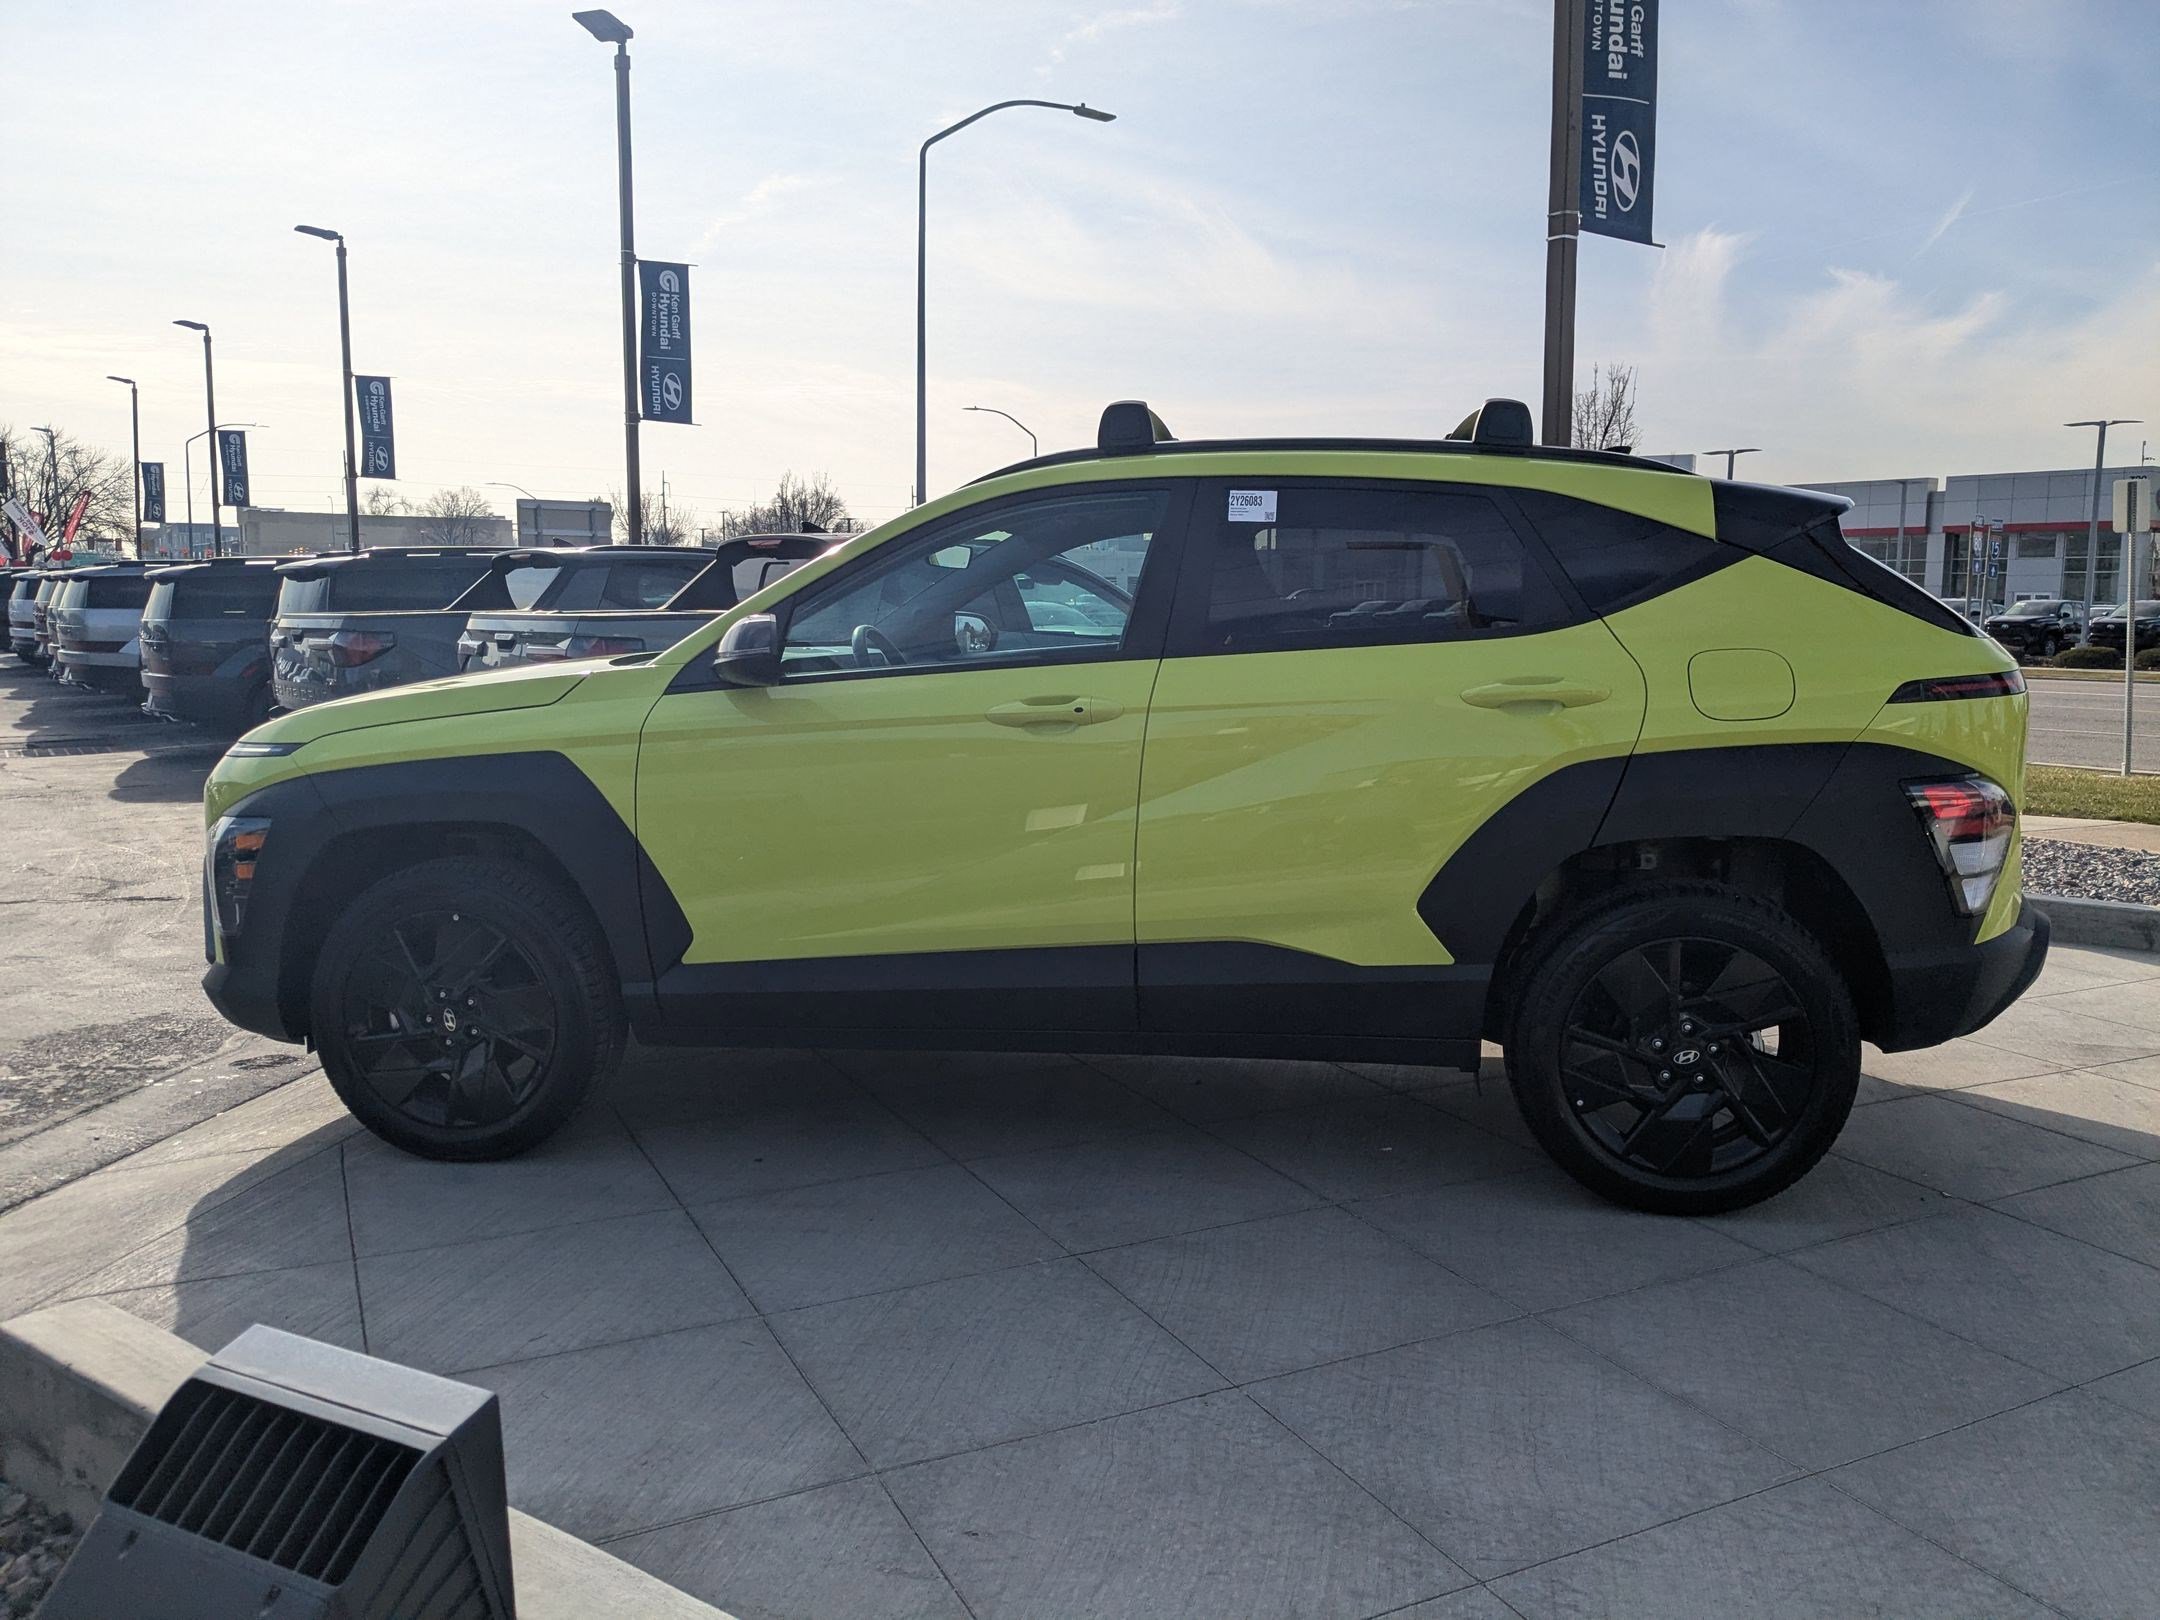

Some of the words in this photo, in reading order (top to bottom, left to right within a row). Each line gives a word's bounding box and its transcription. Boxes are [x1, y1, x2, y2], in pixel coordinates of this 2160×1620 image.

[1630, 4, 1645, 58] Garff
[1592, 114, 1608, 219] HYUNDAI
[658, 293, 671, 350] Hyundai
[671, 294, 680, 313] Ken
[671, 314, 681, 339] Garff
[651, 365, 661, 415] HYUNDAI
[370, 395, 381, 432] Hyundai
[1230, 495, 1263, 507] 2Y26083
[1991, 541, 2000, 555] 15
